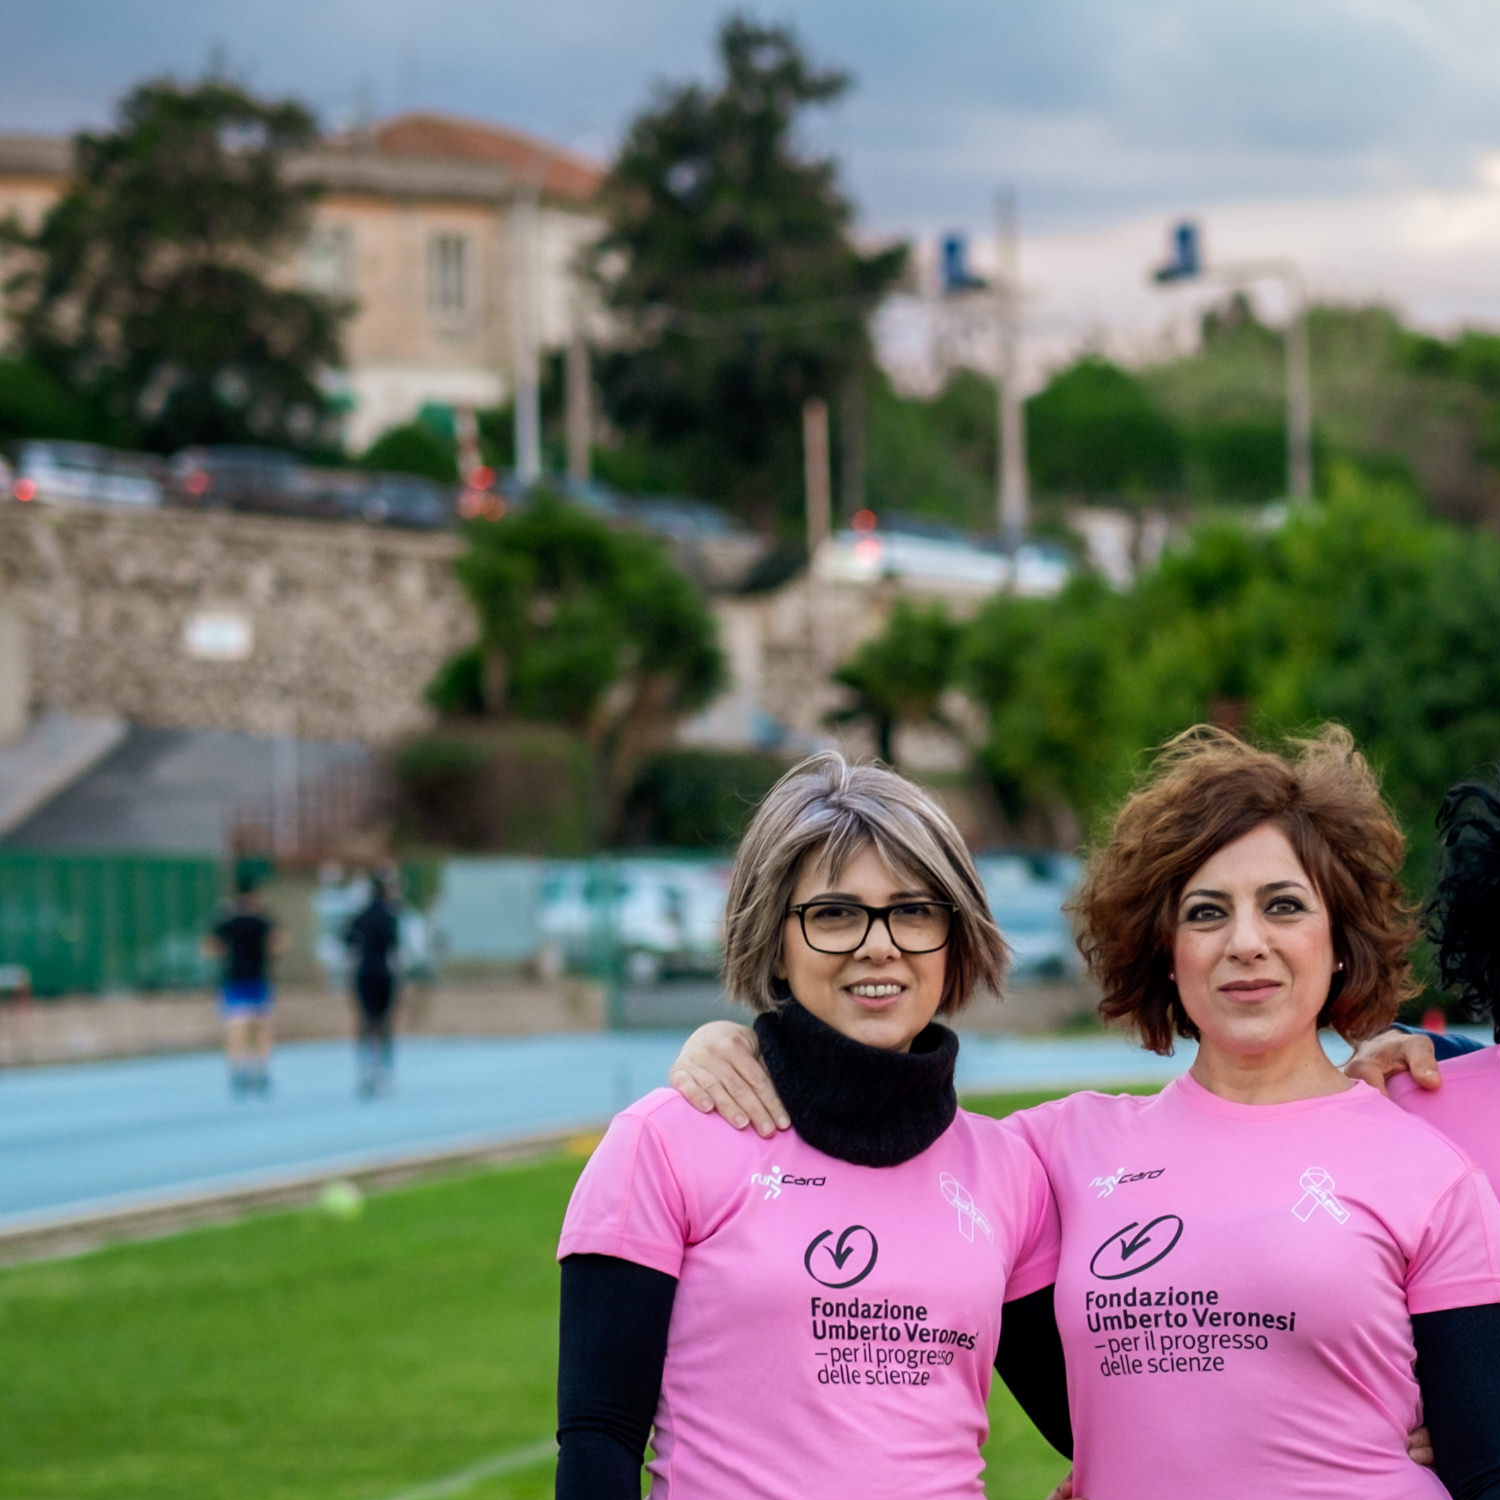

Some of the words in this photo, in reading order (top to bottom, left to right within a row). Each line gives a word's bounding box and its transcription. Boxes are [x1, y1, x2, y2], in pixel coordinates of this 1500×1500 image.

[811, 1297, 927, 1320] Fondazione
[1086, 1286, 1218, 1311] Fondazione
[812, 1320, 899, 1341] Umberto
[1087, 1308, 1188, 1333] Umberto
[1192, 1308, 1296, 1332] Veronesi
[1144, 1331, 1155, 1351] il
[1160, 1332, 1268, 1355] progresso
[863, 1343, 873, 1362] il
[877, 1348, 953, 1369] progresso
[1100, 1355, 1142, 1377] delle
[1148, 1354, 1225, 1374] scienze
[817, 1364, 861, 1385] delle
[865, 1367, 930, 1385] scienze
